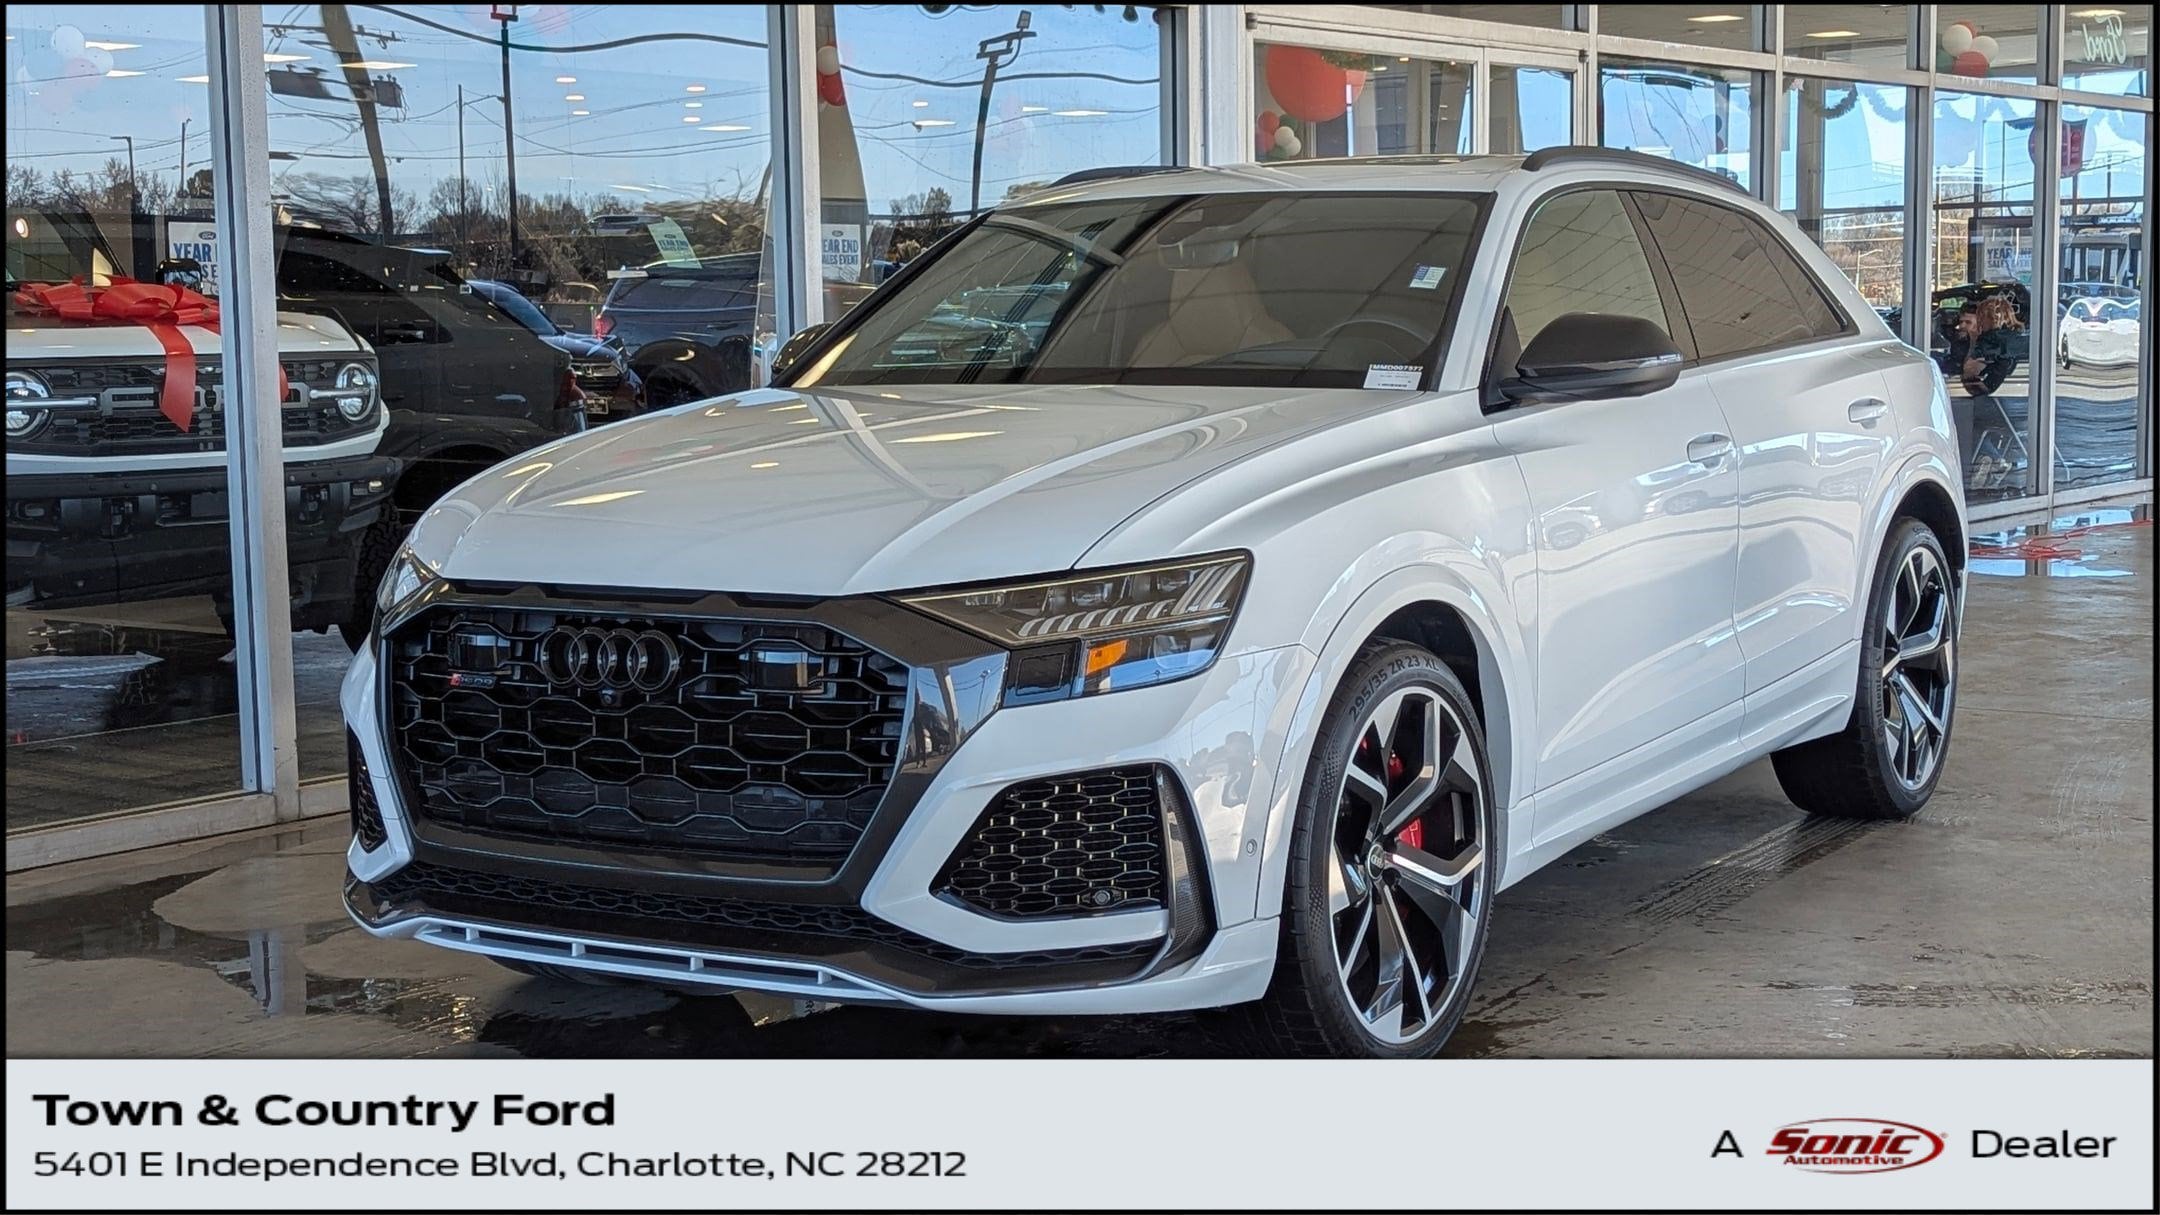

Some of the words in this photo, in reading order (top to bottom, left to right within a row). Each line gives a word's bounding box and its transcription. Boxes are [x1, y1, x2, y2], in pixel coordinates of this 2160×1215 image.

[174, 243, 212, 262] YEAR
[841, 239, 859, 253] END
[1349, 668, 1388, 721] 295/35
[1388, 660, 1406, 675] ZR
[1405, 655, 1420, 668] 23
[1423, 656, 1440, 671] XL
